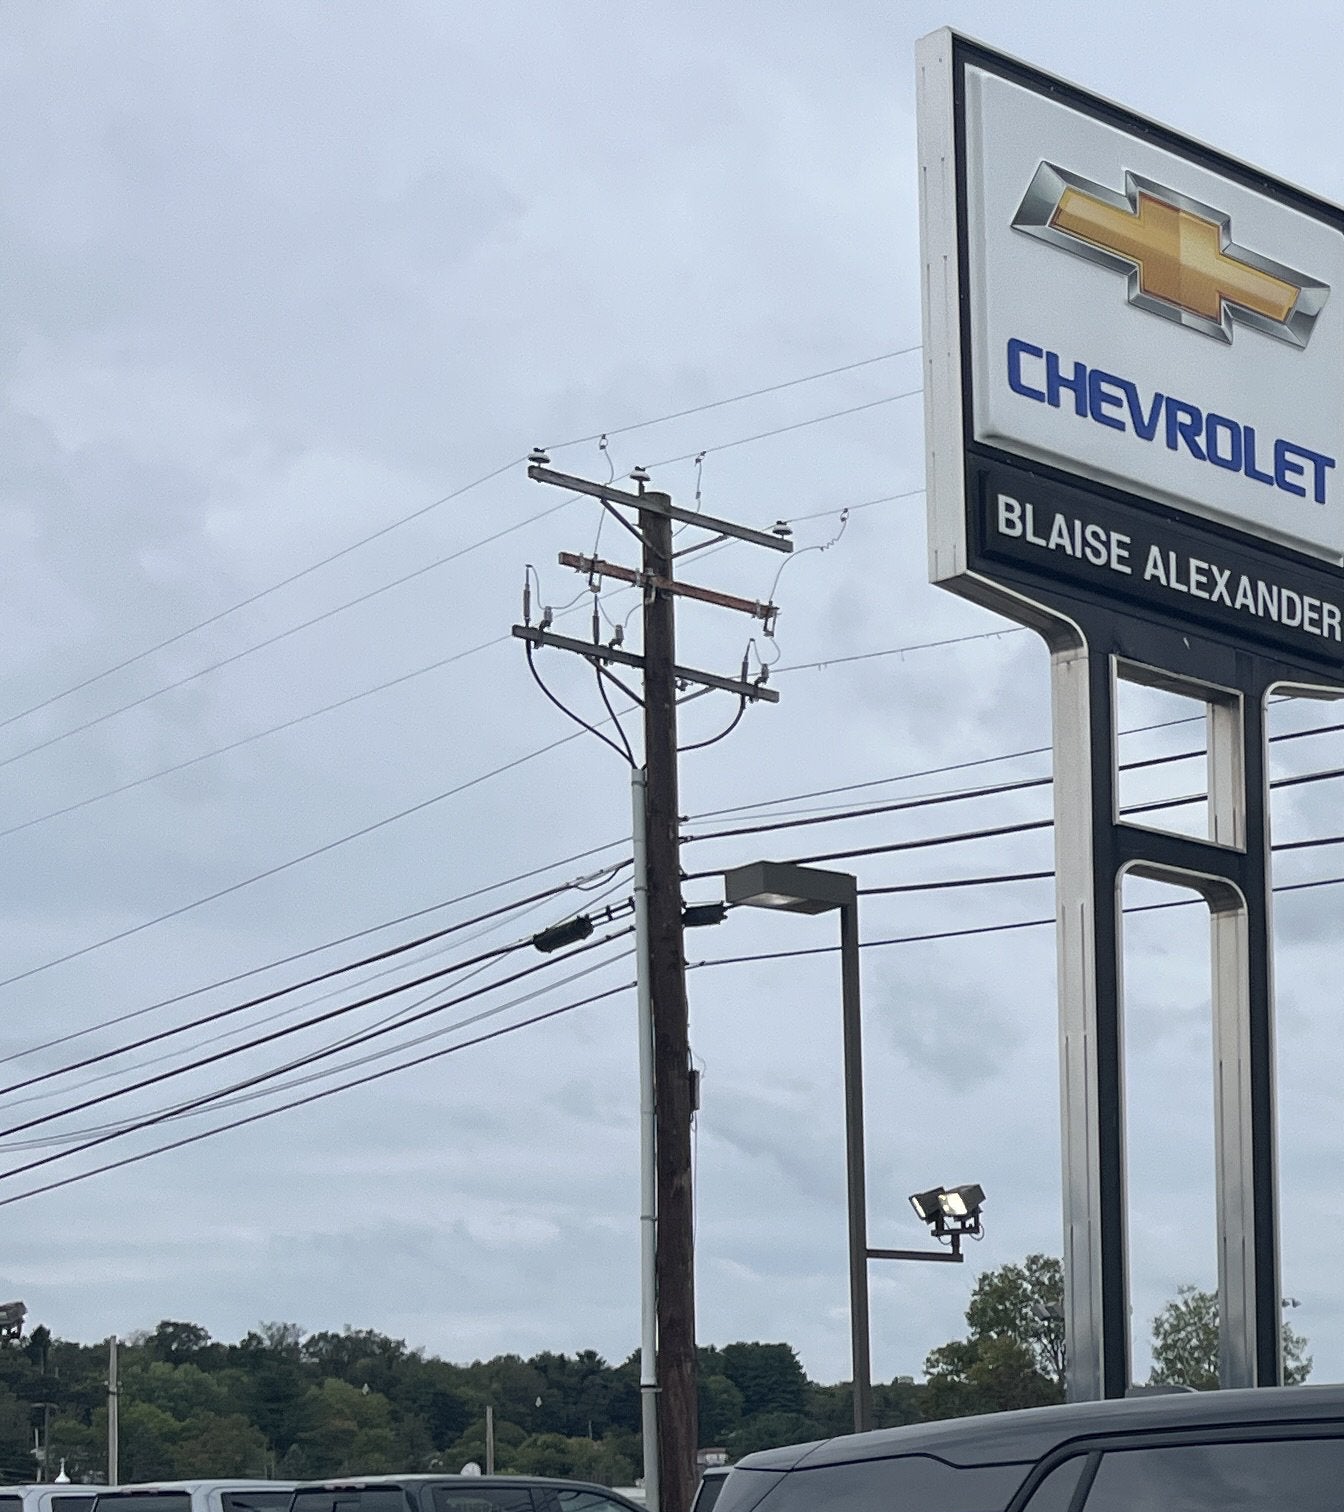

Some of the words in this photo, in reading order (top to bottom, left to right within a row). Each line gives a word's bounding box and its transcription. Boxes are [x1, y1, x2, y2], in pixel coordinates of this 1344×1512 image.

[1007, 337, 1336, 504] CHEVROLET
[997, 494, 1132, 575] BLAISE
[1144, 544, 1342, 641] ALEXANDER
